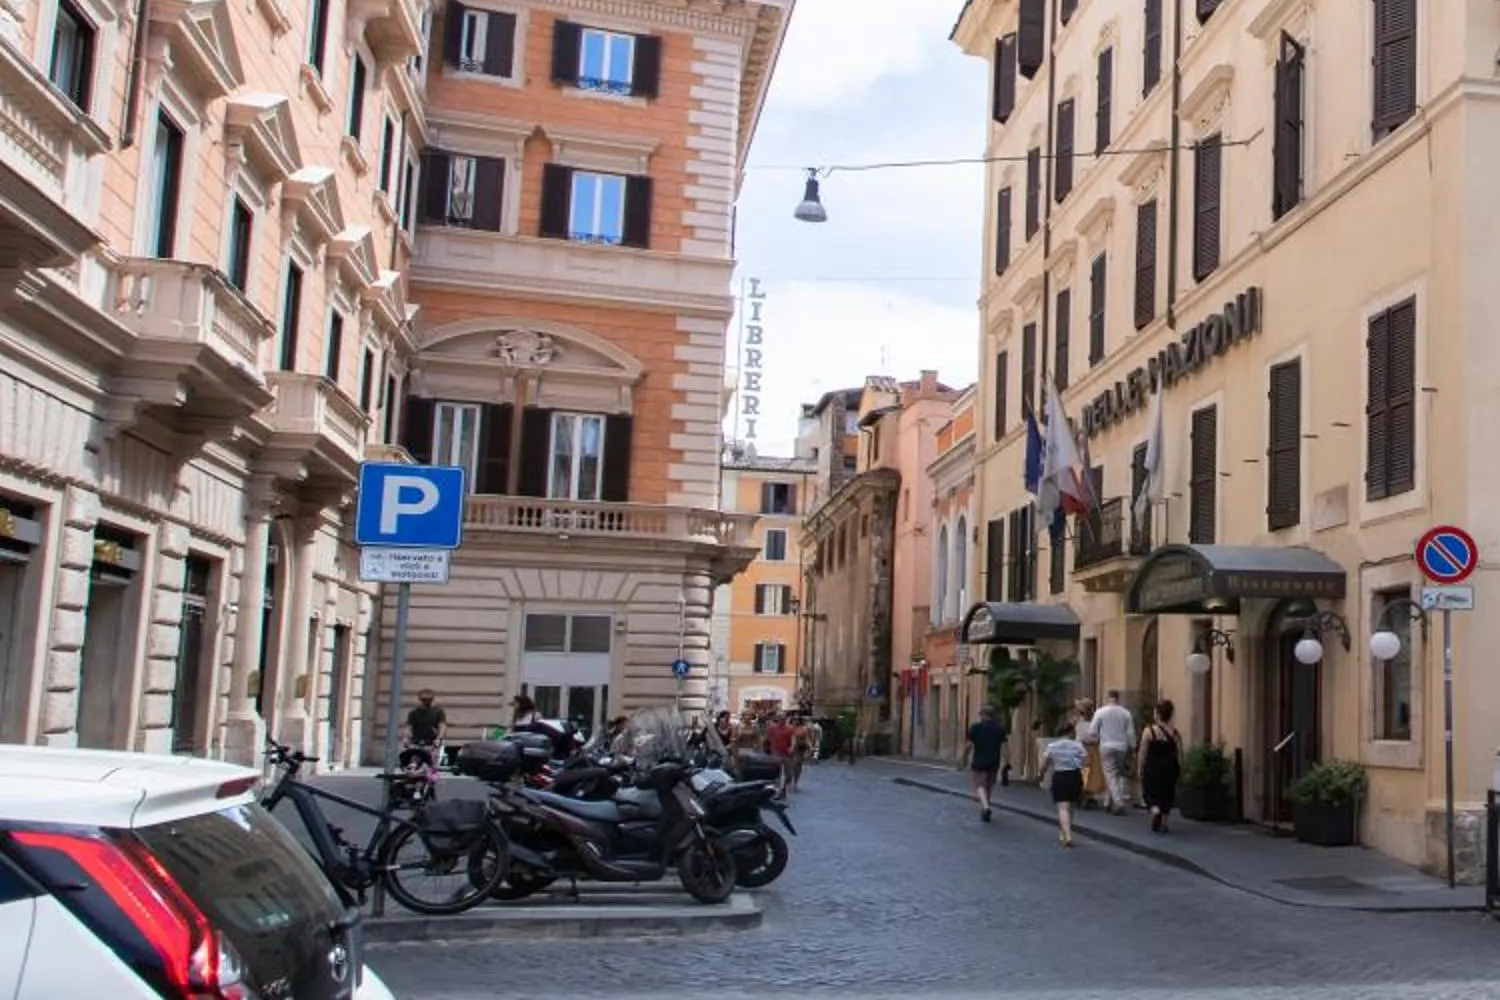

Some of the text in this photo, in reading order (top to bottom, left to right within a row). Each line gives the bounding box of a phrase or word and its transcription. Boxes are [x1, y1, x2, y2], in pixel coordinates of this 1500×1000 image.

[1082, 286, 1263, 439] DELLE NAZIONI
[380, 475, 440, 534] P
[1227, 574, 1337, 591] Ristorante
